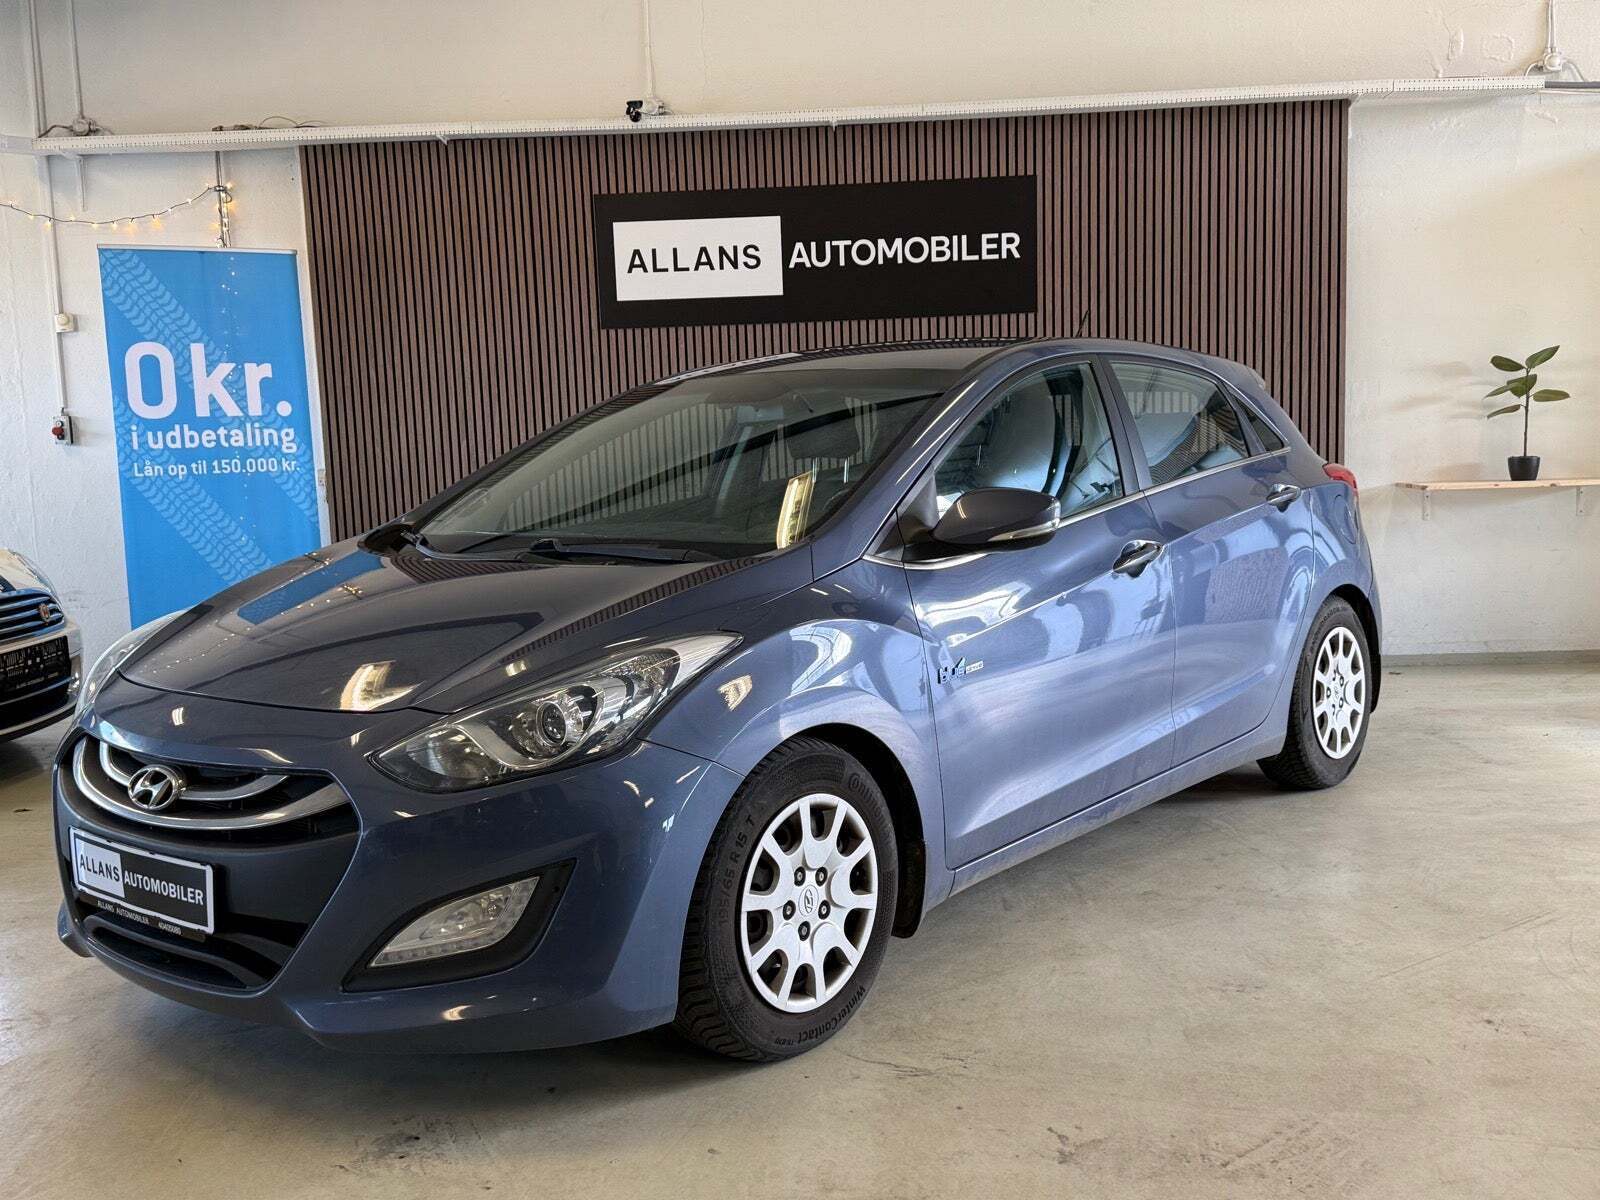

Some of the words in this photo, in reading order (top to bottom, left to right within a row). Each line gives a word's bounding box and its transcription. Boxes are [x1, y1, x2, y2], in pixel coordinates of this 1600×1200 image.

[627, 244, 762, 274] ALLANS
[788, 232, 1022, 270] AUTOMOBILER
[124, 341, 177, 419] 0
[190, 342, 293, 418] kr.
[130, 424, 140, 450] i
[147, 423, 298, 454] udbetaling
[133, 460, 164, 477] Lån
[168, 463, 188, 480] op
[191, 460, 207, 475] til
[212, 457, 278, 474] 150.000
[282, 457, 300, 472] kr.
[79, 854, 120, 882] ALLANS
[124, 870, 204, 905] AUTOMOBILER
[798, 985, 866, 1044] WinterContact
